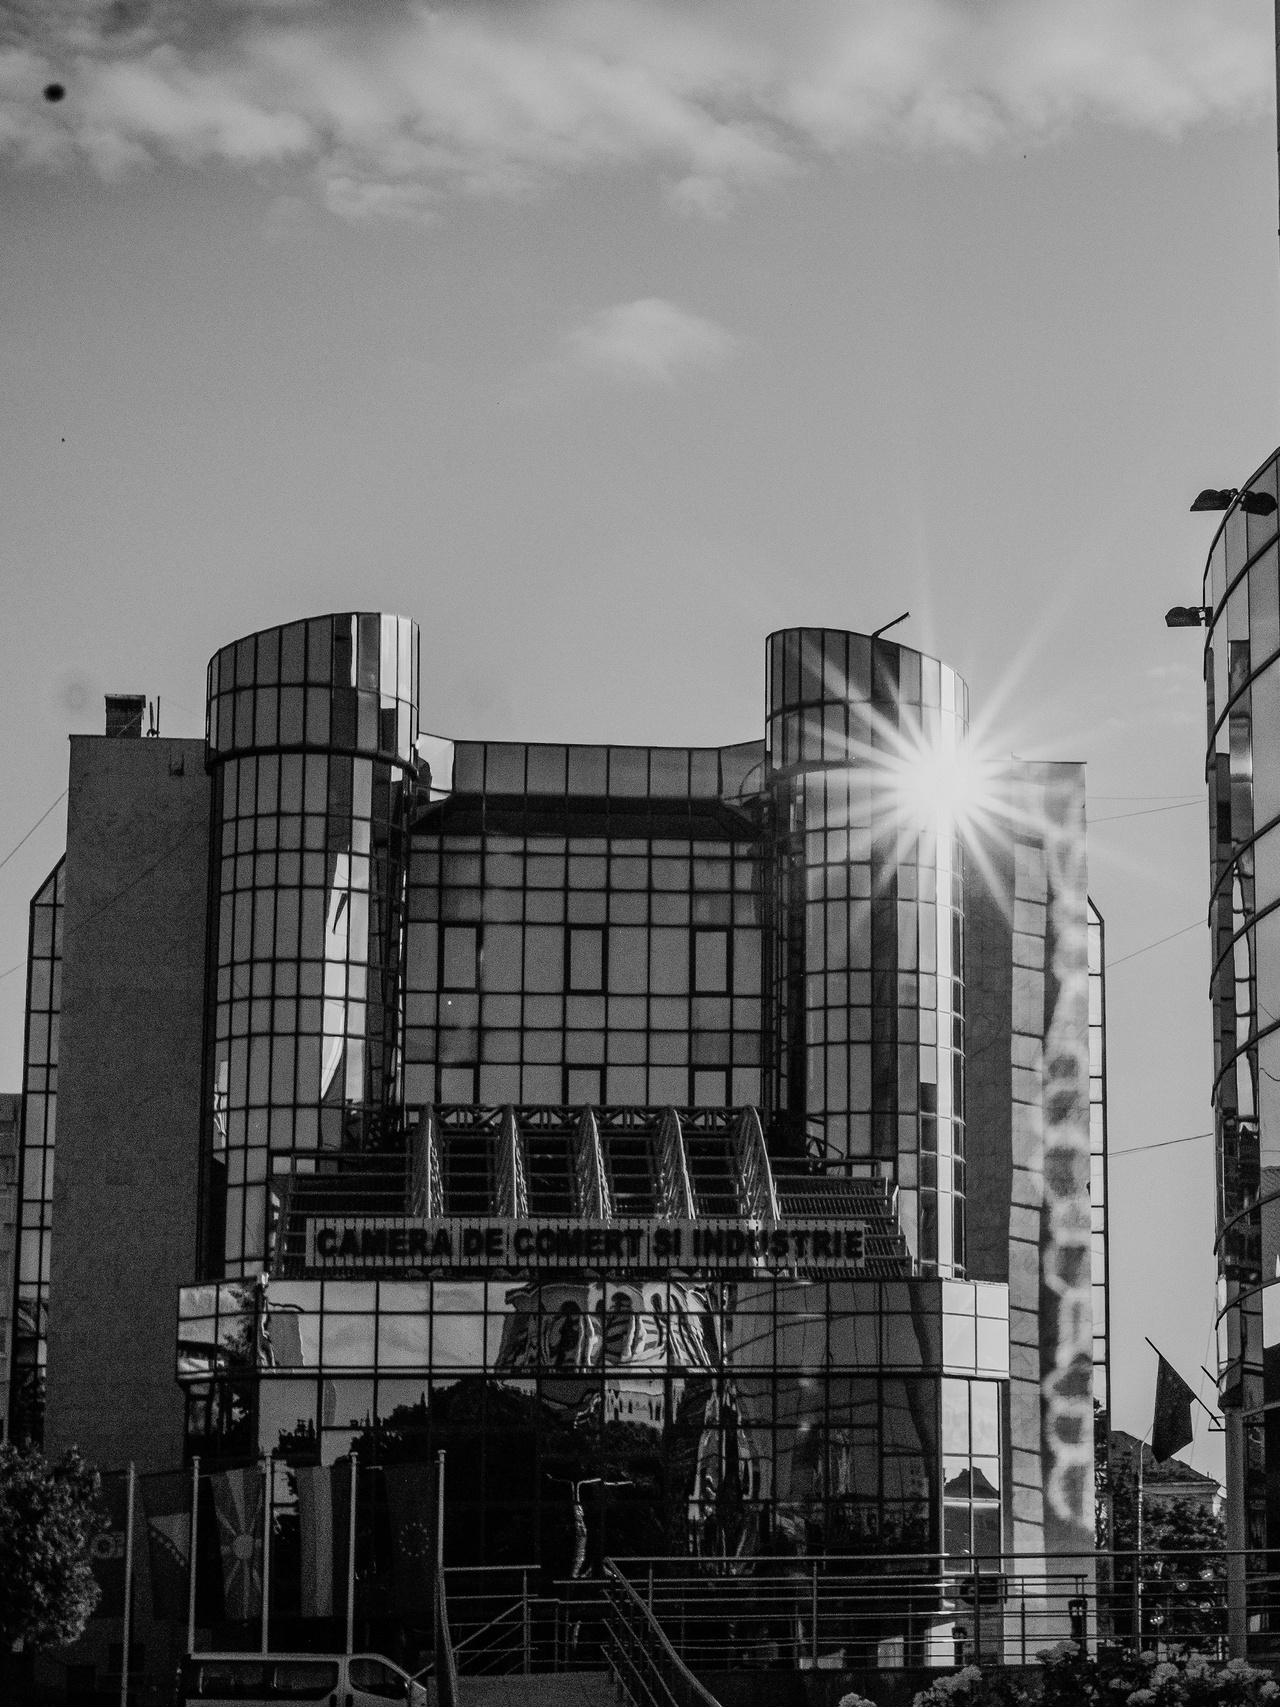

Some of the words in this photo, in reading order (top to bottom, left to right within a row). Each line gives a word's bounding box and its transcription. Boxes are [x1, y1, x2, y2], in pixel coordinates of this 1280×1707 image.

[317, 1228, 451, 1257] CAMERA
[463, 1228, 504, 1257] DE
[653, 1228, 682, 1257] SI
[693, 1229, 864, 1259] INDUSTRIE
